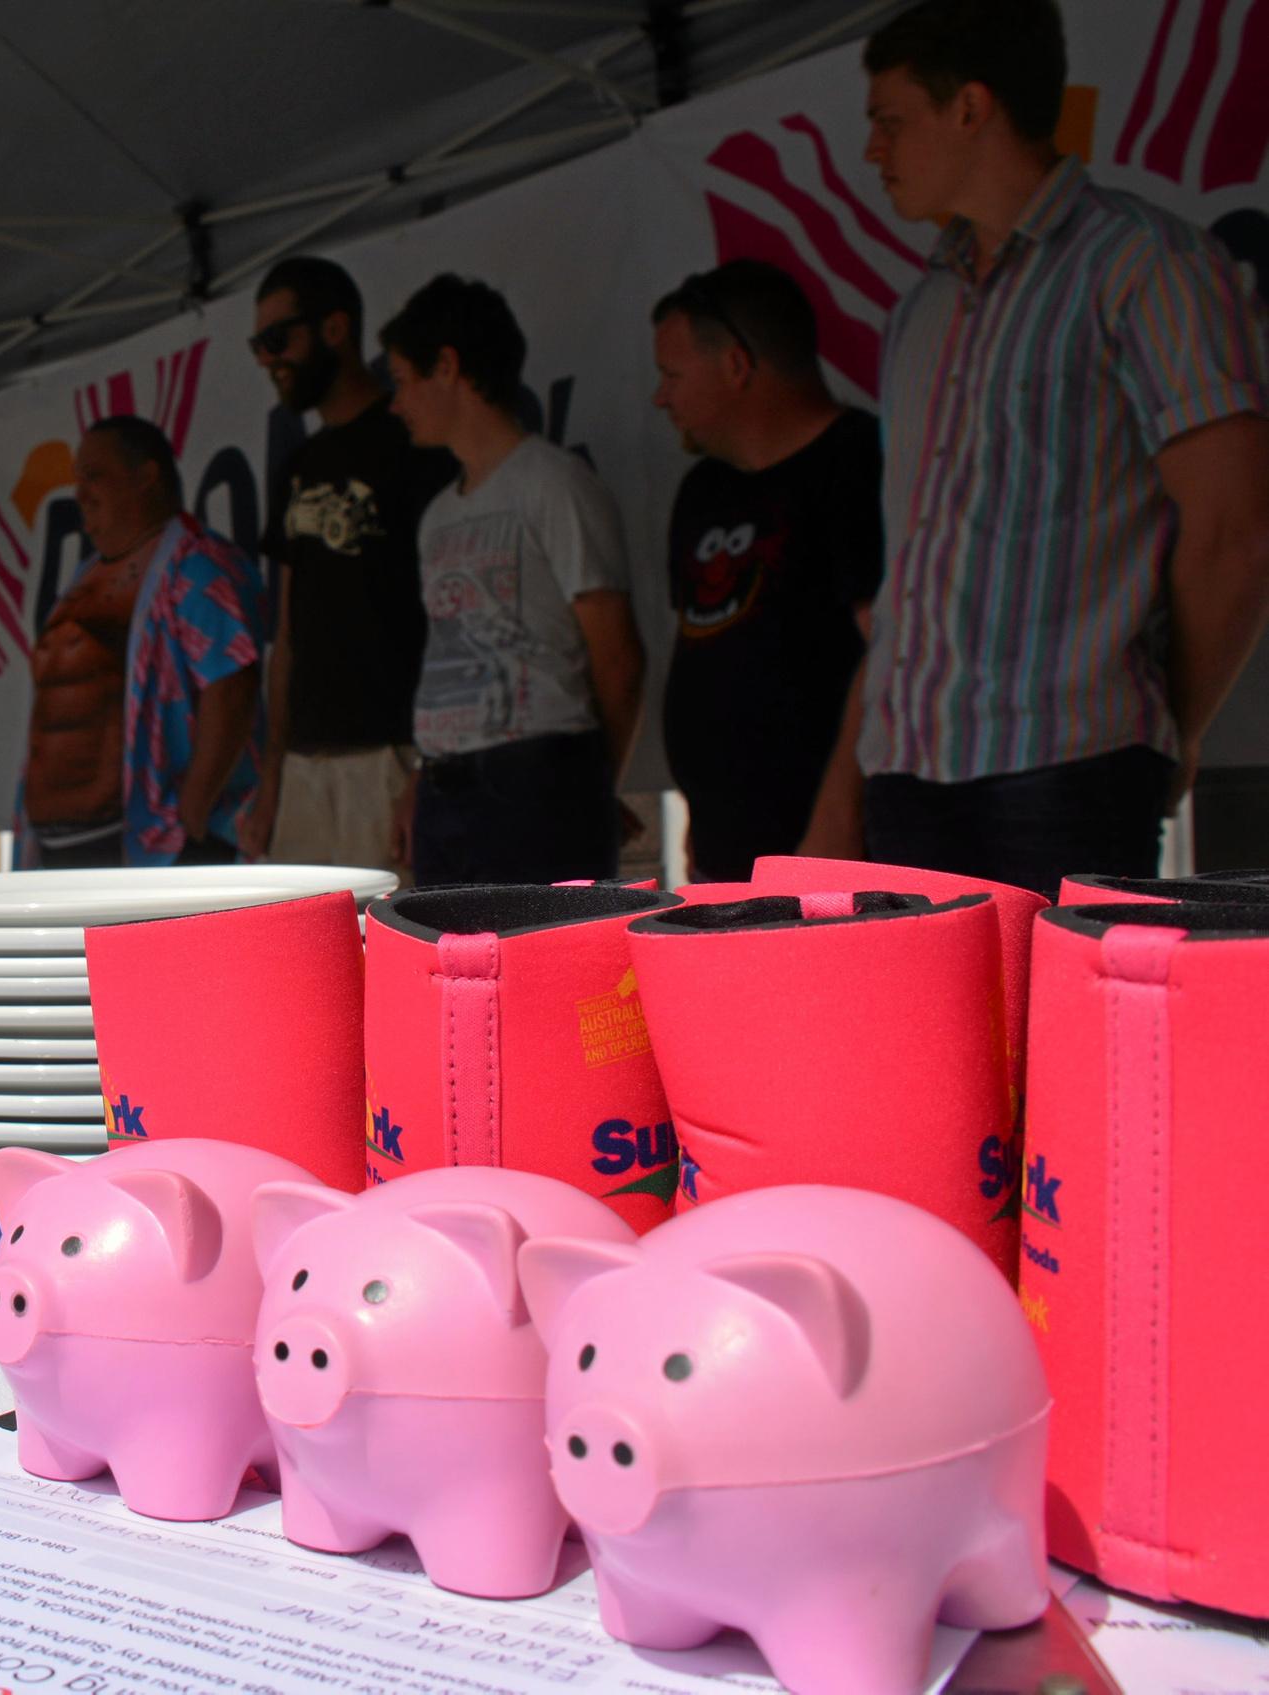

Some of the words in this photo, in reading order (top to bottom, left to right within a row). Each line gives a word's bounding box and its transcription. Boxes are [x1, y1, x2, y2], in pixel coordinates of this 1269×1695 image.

[580, 1001, 643, 1036] AUSTRALI
[111, 1094, 149, 1138] rk
[371, 1106, 405, 1161] rk
[1025, 1155, 1063, 1223] rk
[21, 1536, 40, 1544] of
[220, 1523, 288, 1541] ationship
[39, 1539, 78, 1554] Date
[12, 1566, 66, 1584] signed
[65, 1579, 99, 1592] and
[35, 1585, 124, 1614] BaconFest
[98, 1587, 127, 1599] out
[126, 1595, 169, 1612] filled
[33, 1597, 112, 1625] MEDICAL
[126, 1608, 201, 1635] Kingaroy
[170, 1607, 263, 1635] completely
[25, 1623, 113, 1654] SunPork
[119, 1621, 243, 1659] PERMISSION
[202, 1629, 235, 1644] The
[237, 1640, 261, 1648] of
[265, 1631, 308, 1647] form
[24, 1644, 86, 1667] friend
[114, 1647, 143, 1663] by
[261, 1645, 363, 1675] contestant
[310, 1644, 344, 1658] this
[87, 1660, 106, 1669] a
[102, 1665, 148, 1682] and
[141, 1656, 237, 1688] donated
[255, 1659, 352, 1688] LIABILITY
[345, 1652, 416, 1674] without
